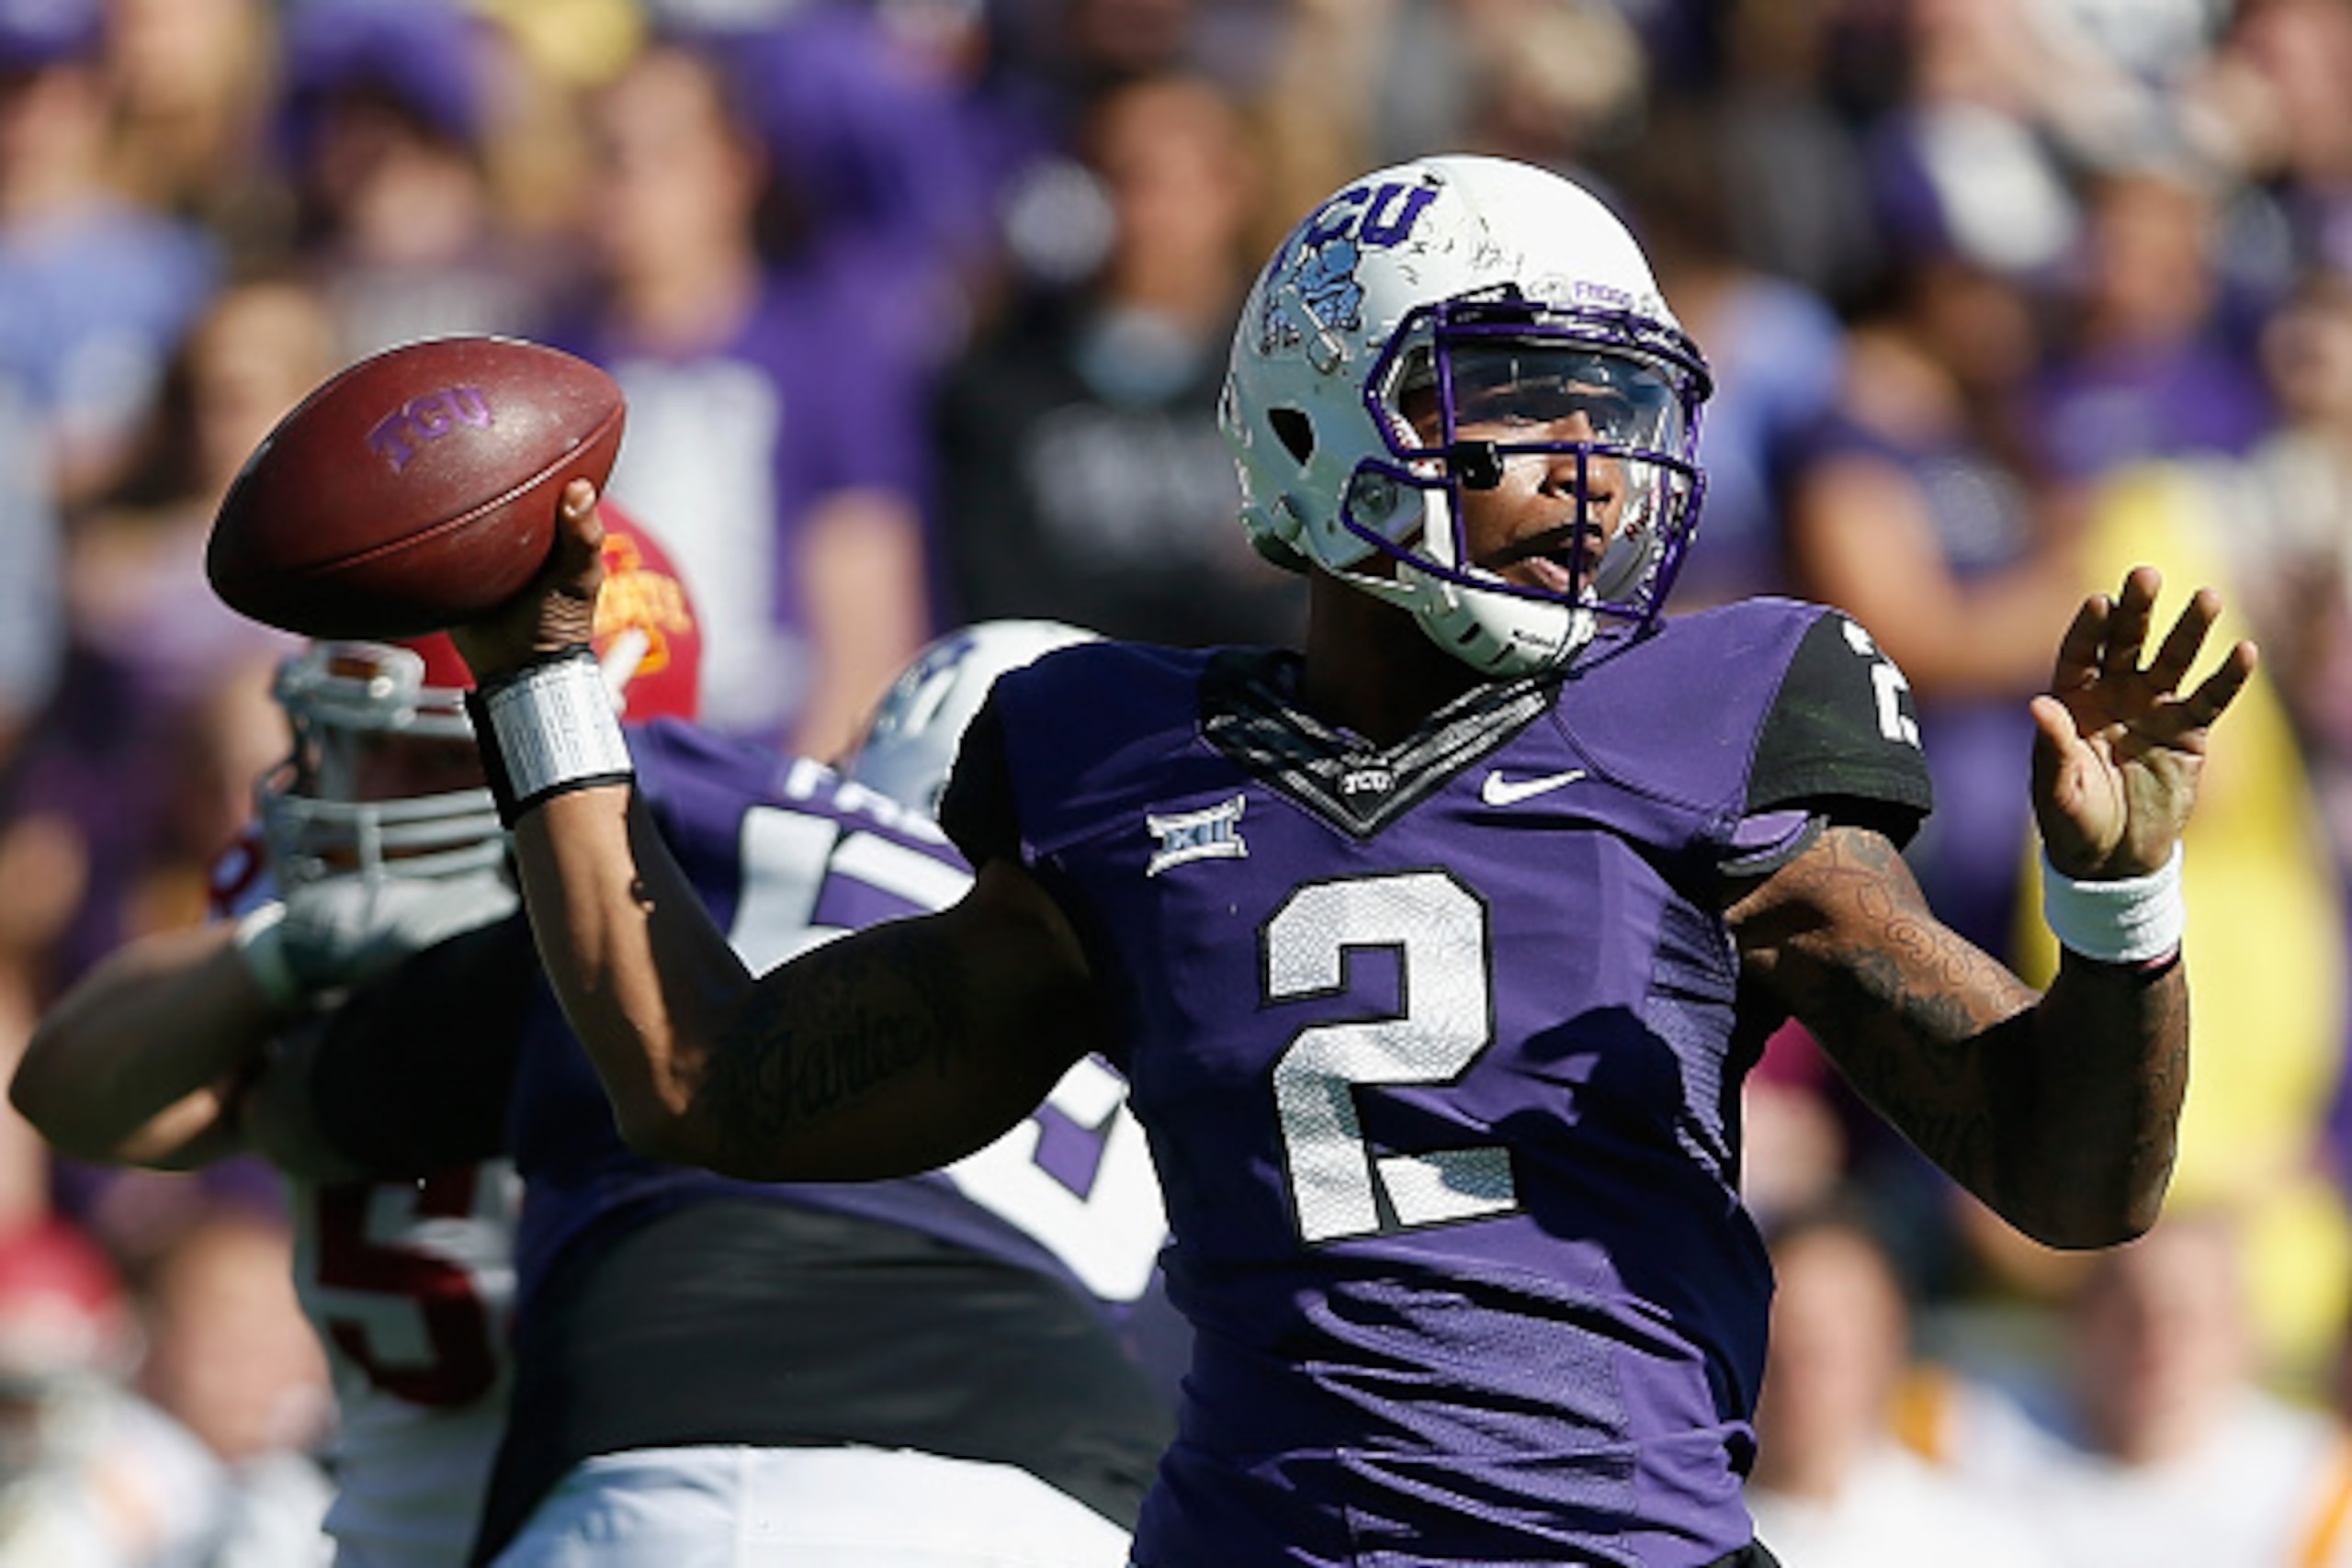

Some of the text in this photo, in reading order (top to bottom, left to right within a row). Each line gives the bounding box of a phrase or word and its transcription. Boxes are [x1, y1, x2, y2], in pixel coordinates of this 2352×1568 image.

[367, 387, 492, 474] TCU
[1841, 619, 1922, 751] 2
[1343, 770, 1392, 795] TCU
[1261, 870, 1521, 1245] 2
